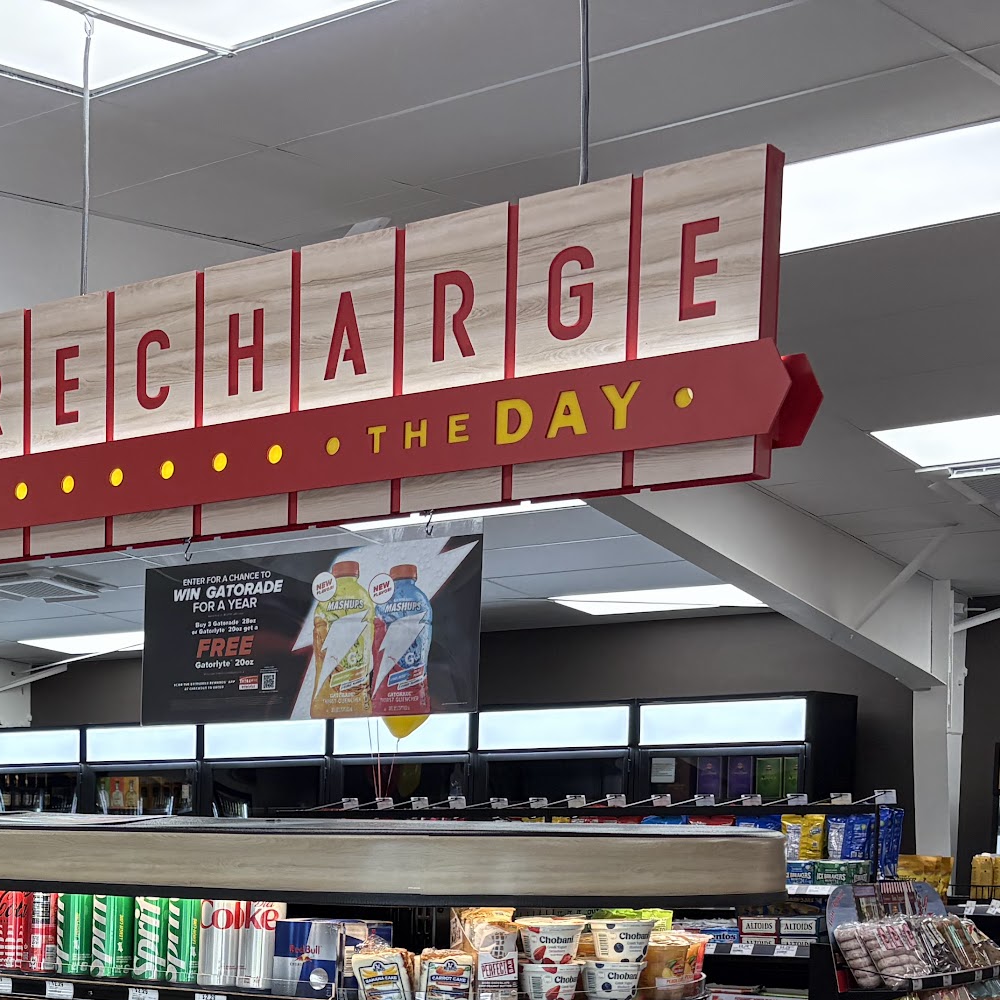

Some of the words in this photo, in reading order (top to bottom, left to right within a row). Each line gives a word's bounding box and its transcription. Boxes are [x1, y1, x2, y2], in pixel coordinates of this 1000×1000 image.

[367, 412, 471, 455] THE
[495, 379, 643, 447] DAY
[183, 578, 205, 586] ENTER
[206, 576, 220, 584] FOR
[228, 572, 260, 582] CHANCE
[260, 570, 272, 578] TO
[316, 578, 333, 590] NEW
[173, 587, 201, 602] WIN
[206, 579, 284, 599] GATORADE
[373, 580, 390, 593] NEW
[192, 601, 216, 613] FOR
[217, 600, 226, 611] A
[228, 597, 258, 610] YEAR
[326, 600, 364, 612] MASHUPS
[384, 601, 421, 613] MASHUPS
[196, 635, 255, 658] FREE
[195, 660, 231, 670] Gatorlyte
[746, 922, 773, 930] ALTOIDS
[784, 922, 813, 930] ALTOIDS
[538, 935, 574, 944] Chobani
[481, 960, 507, 980] PERFECT
